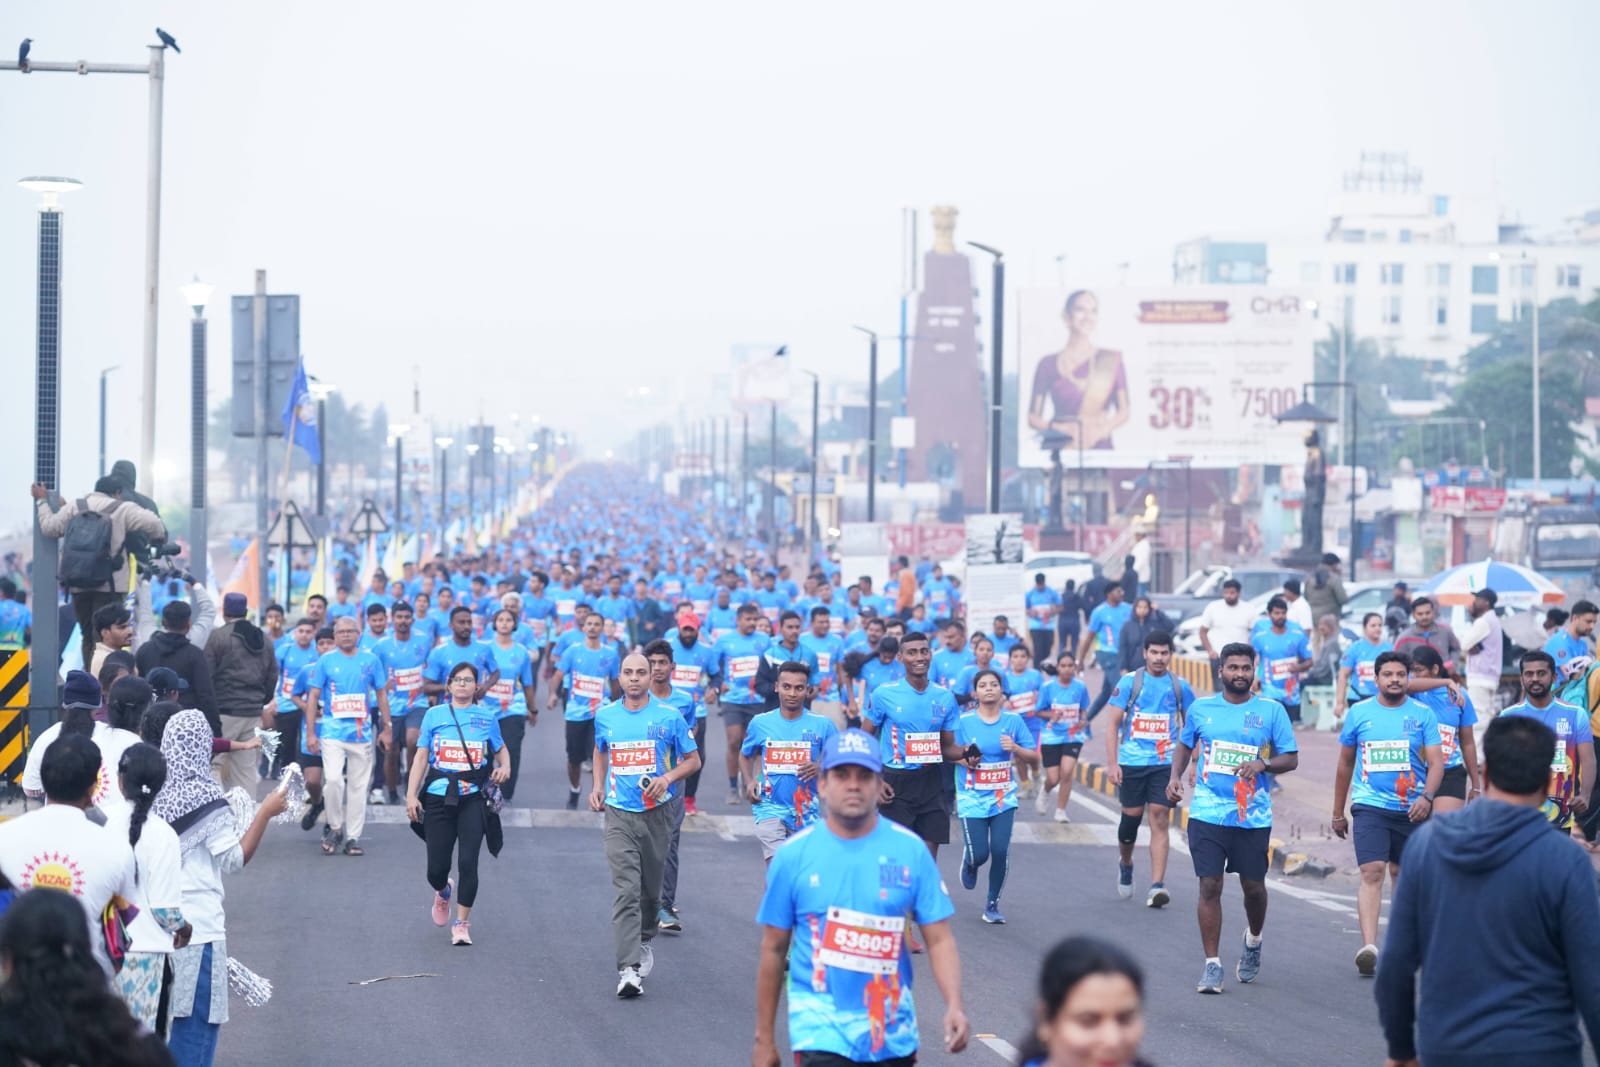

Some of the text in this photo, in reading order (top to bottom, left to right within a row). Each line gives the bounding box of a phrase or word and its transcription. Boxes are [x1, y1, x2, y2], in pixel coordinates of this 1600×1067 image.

[615, 751, 650, 762] 57754
[771, 750, 805, 761] 57817
[1372, 750, 1404, 761] 17131
[35, 873, 71, 887] VIZAG
[834, 928, 893, 952] 53605
